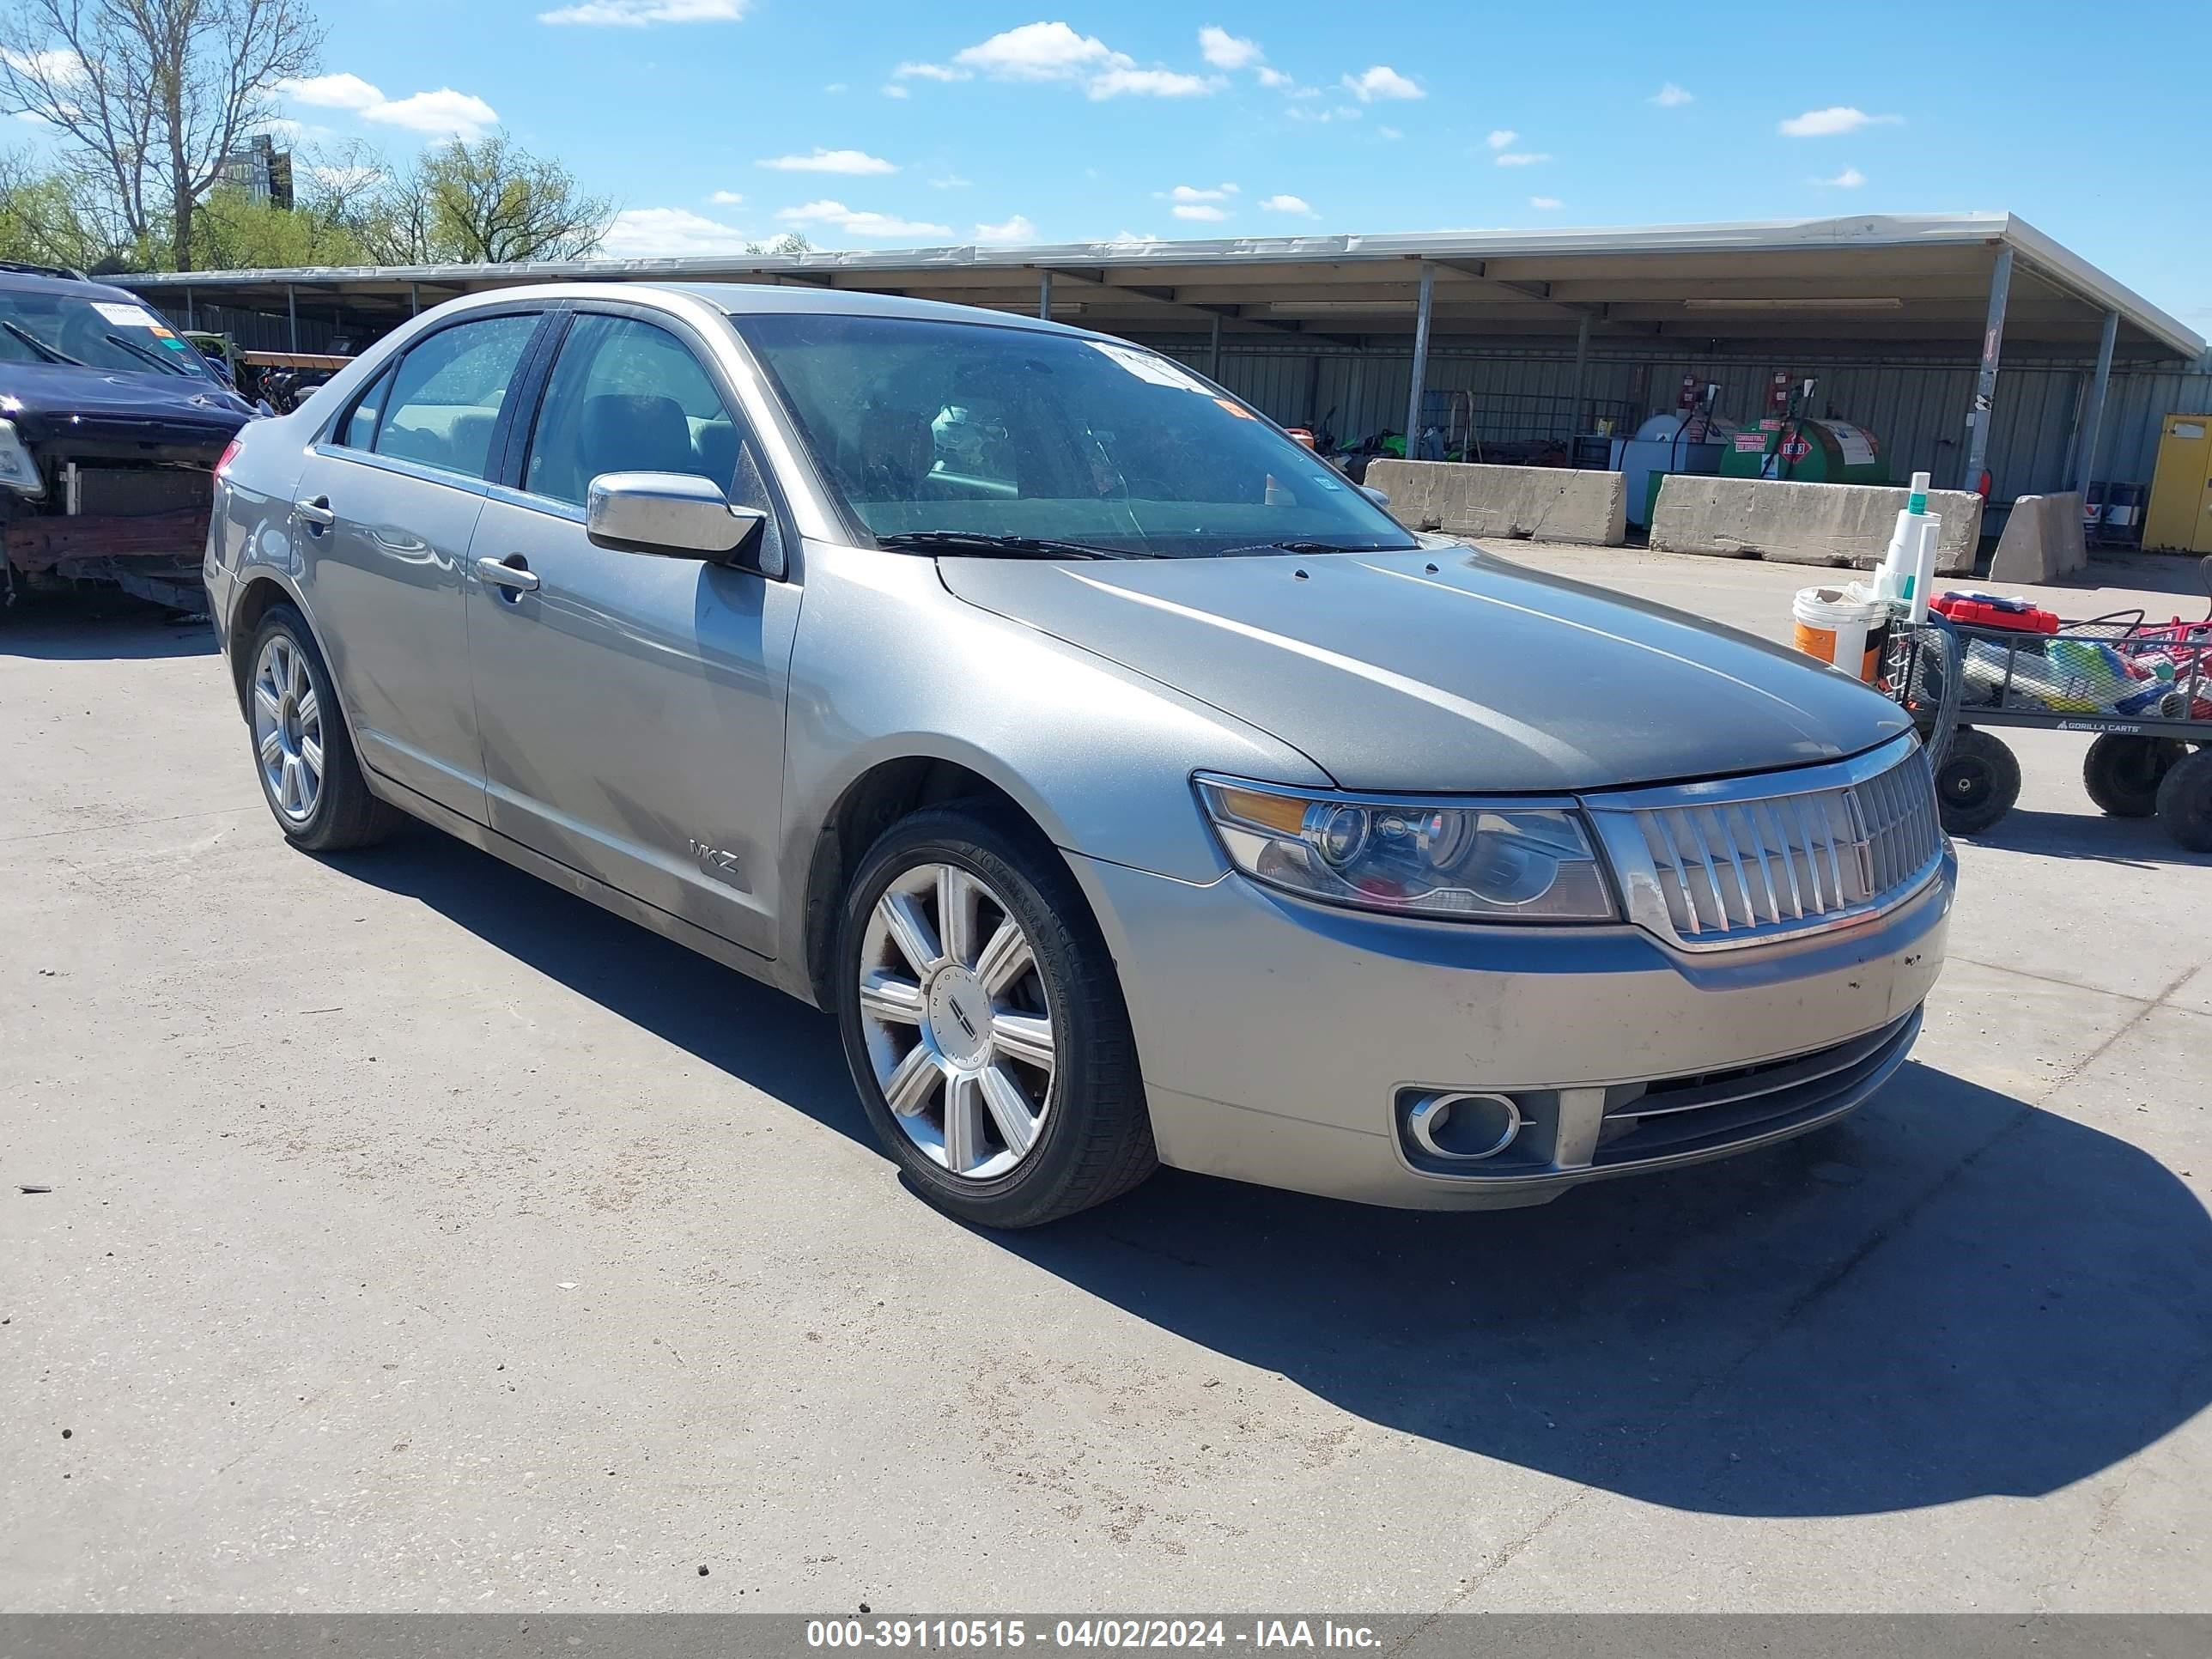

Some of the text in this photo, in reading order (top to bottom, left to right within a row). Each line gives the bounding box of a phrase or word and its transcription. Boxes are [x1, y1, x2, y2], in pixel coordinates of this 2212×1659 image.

[1785, 444, 1804, 453] 193
[2068, 722, 2106, 731] GORILLA
[690, 838, 738, 873] MKZ
[933, 971, 972, 1036] LINCOLN
